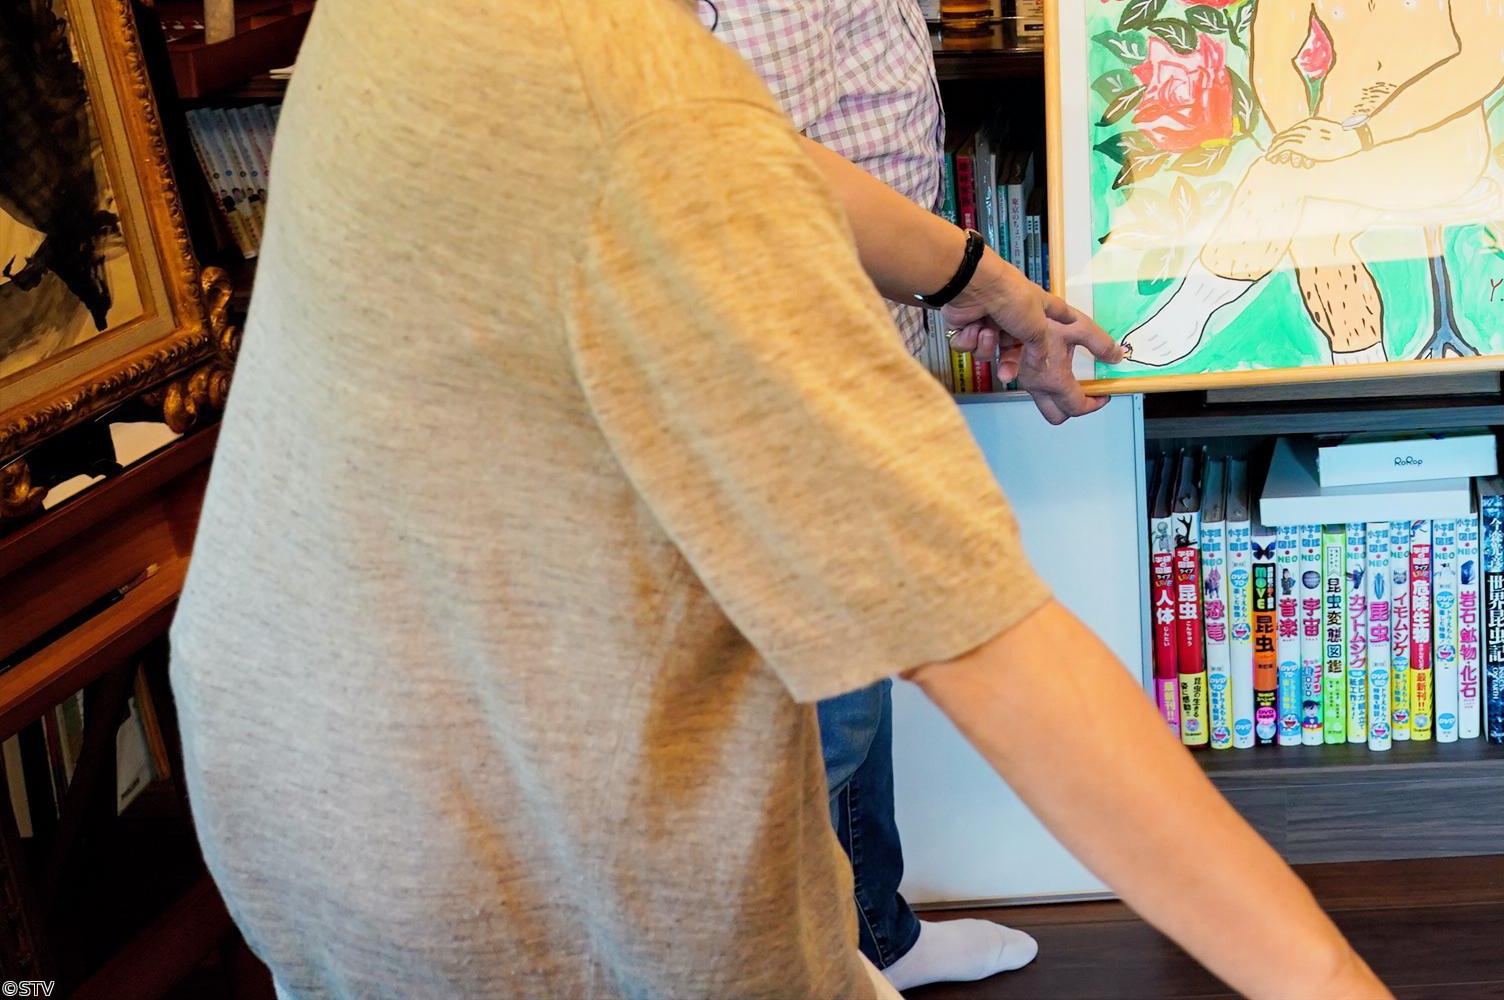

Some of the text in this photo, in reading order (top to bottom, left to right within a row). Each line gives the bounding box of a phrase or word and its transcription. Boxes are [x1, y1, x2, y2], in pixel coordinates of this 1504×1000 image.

[1490, 278, 1504, 303] Y.
[1156, 590, 1175, 624] 人体
[1178, 584, 1198, 619] 昆虫
[1254, 567, 1266, 609] MOVE
[1205, 601, 1227, 642] 恐竜
[1279, 599, 1298, 637] 音楽
[1302, 598, 1321, 637] 宇宙
[1326, 577, 1343, 674] 昆虫変態図鑑
[1370, 601, 1390, 643] 昆虫
[1412, 580, 1431, 644] 危険生物
[1255, 615, 1275, 653] 昆虫
[1460, 590, 1477, 698] 岩石・鉱物・化石
